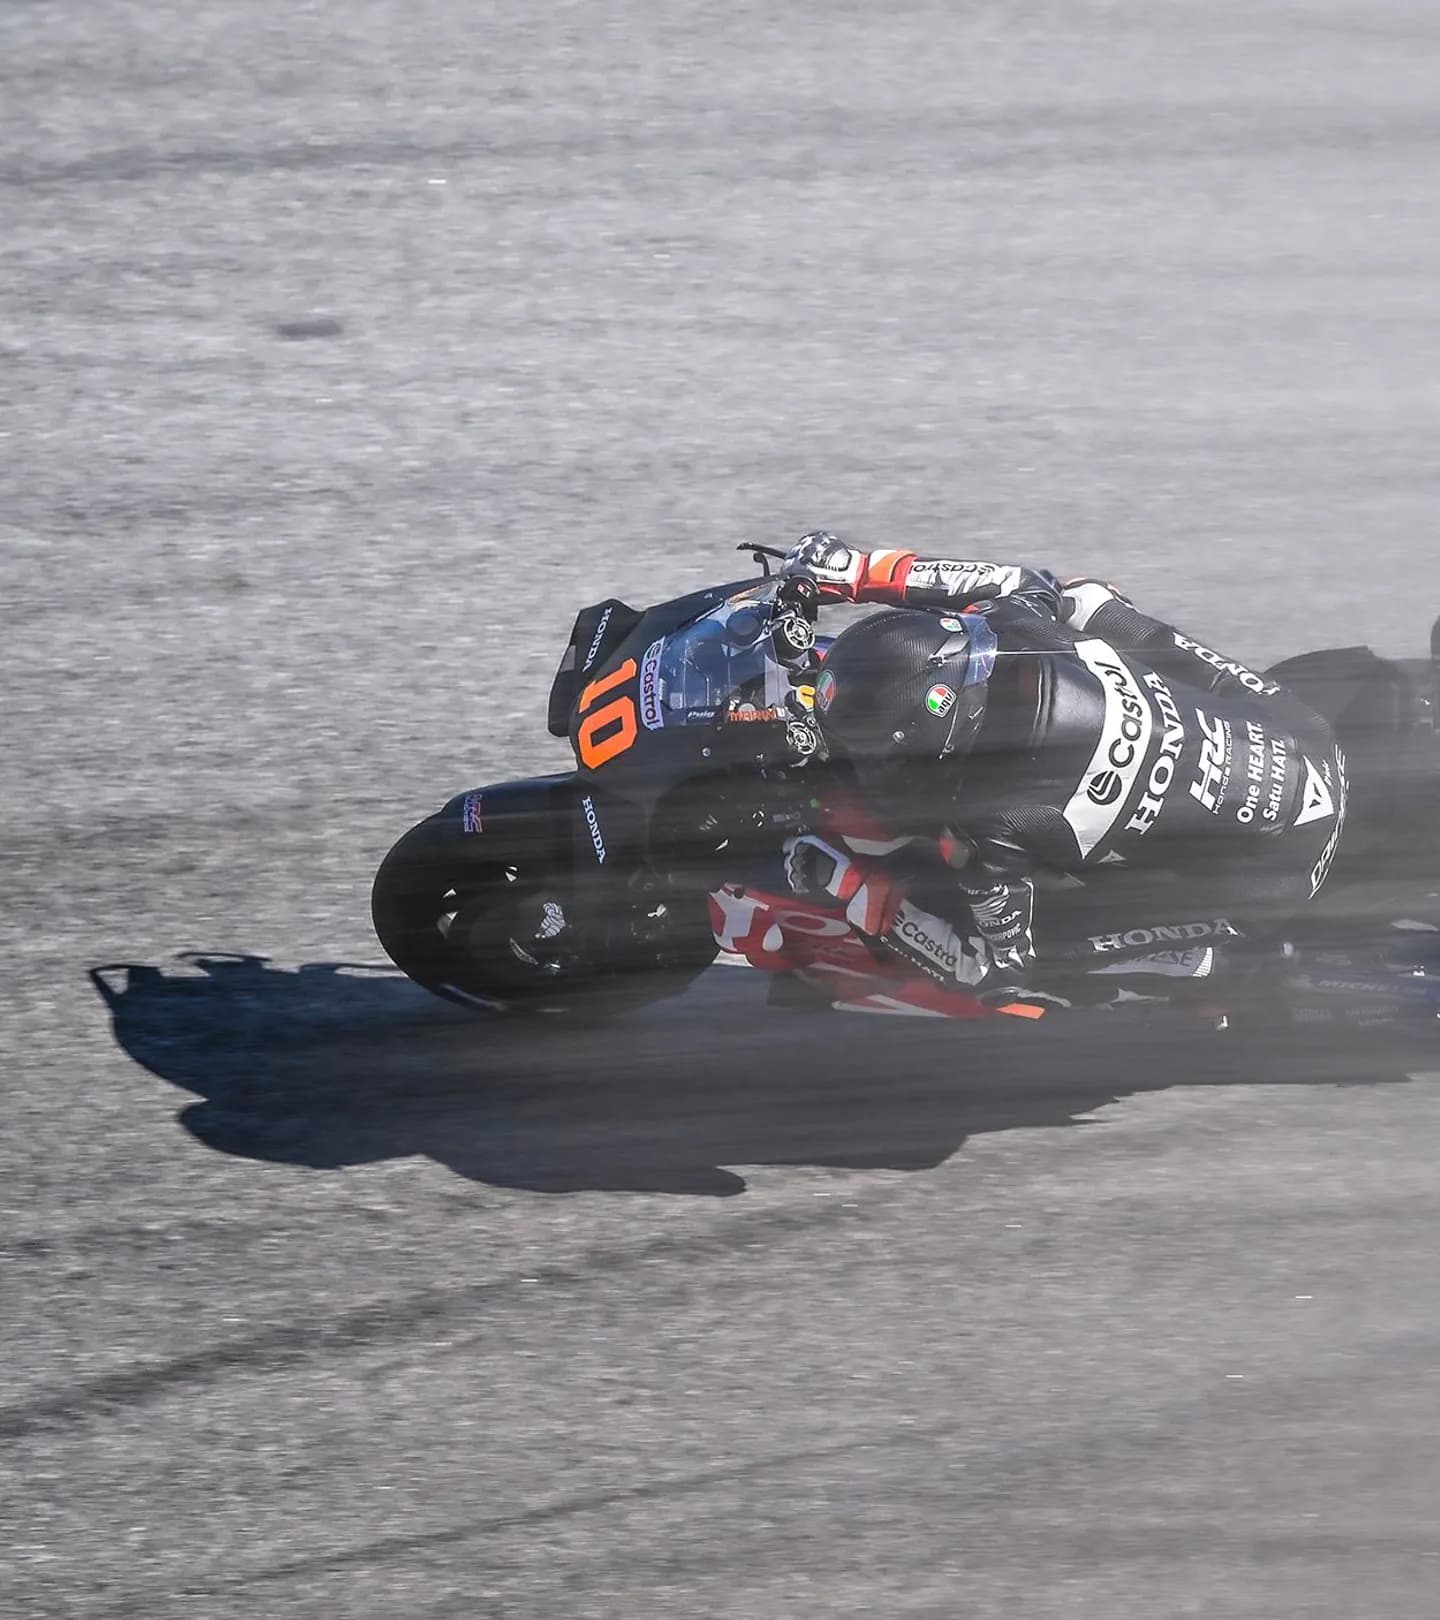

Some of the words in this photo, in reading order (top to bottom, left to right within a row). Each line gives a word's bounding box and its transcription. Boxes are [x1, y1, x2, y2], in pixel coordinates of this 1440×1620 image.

[581, 607, 613, 672] HONDA
[578, 657, 638, 770] 10
[642, 658, 659, 732] Castrol
[937, 692, 954, 714] agv
[1094, 660, 1144, 769] Castrol
[1125, 671, 1185, 836] HONDA
[1189, 707, 1225, 811] HRC
[582, 796, 607, 864] HONDA
[1236, 785, 1261, 824] One
[1263, 783, 1284, 821] Satu
[902, 921, 958, 967] Castro
[1088, 917, 1247, 952] HONDA
